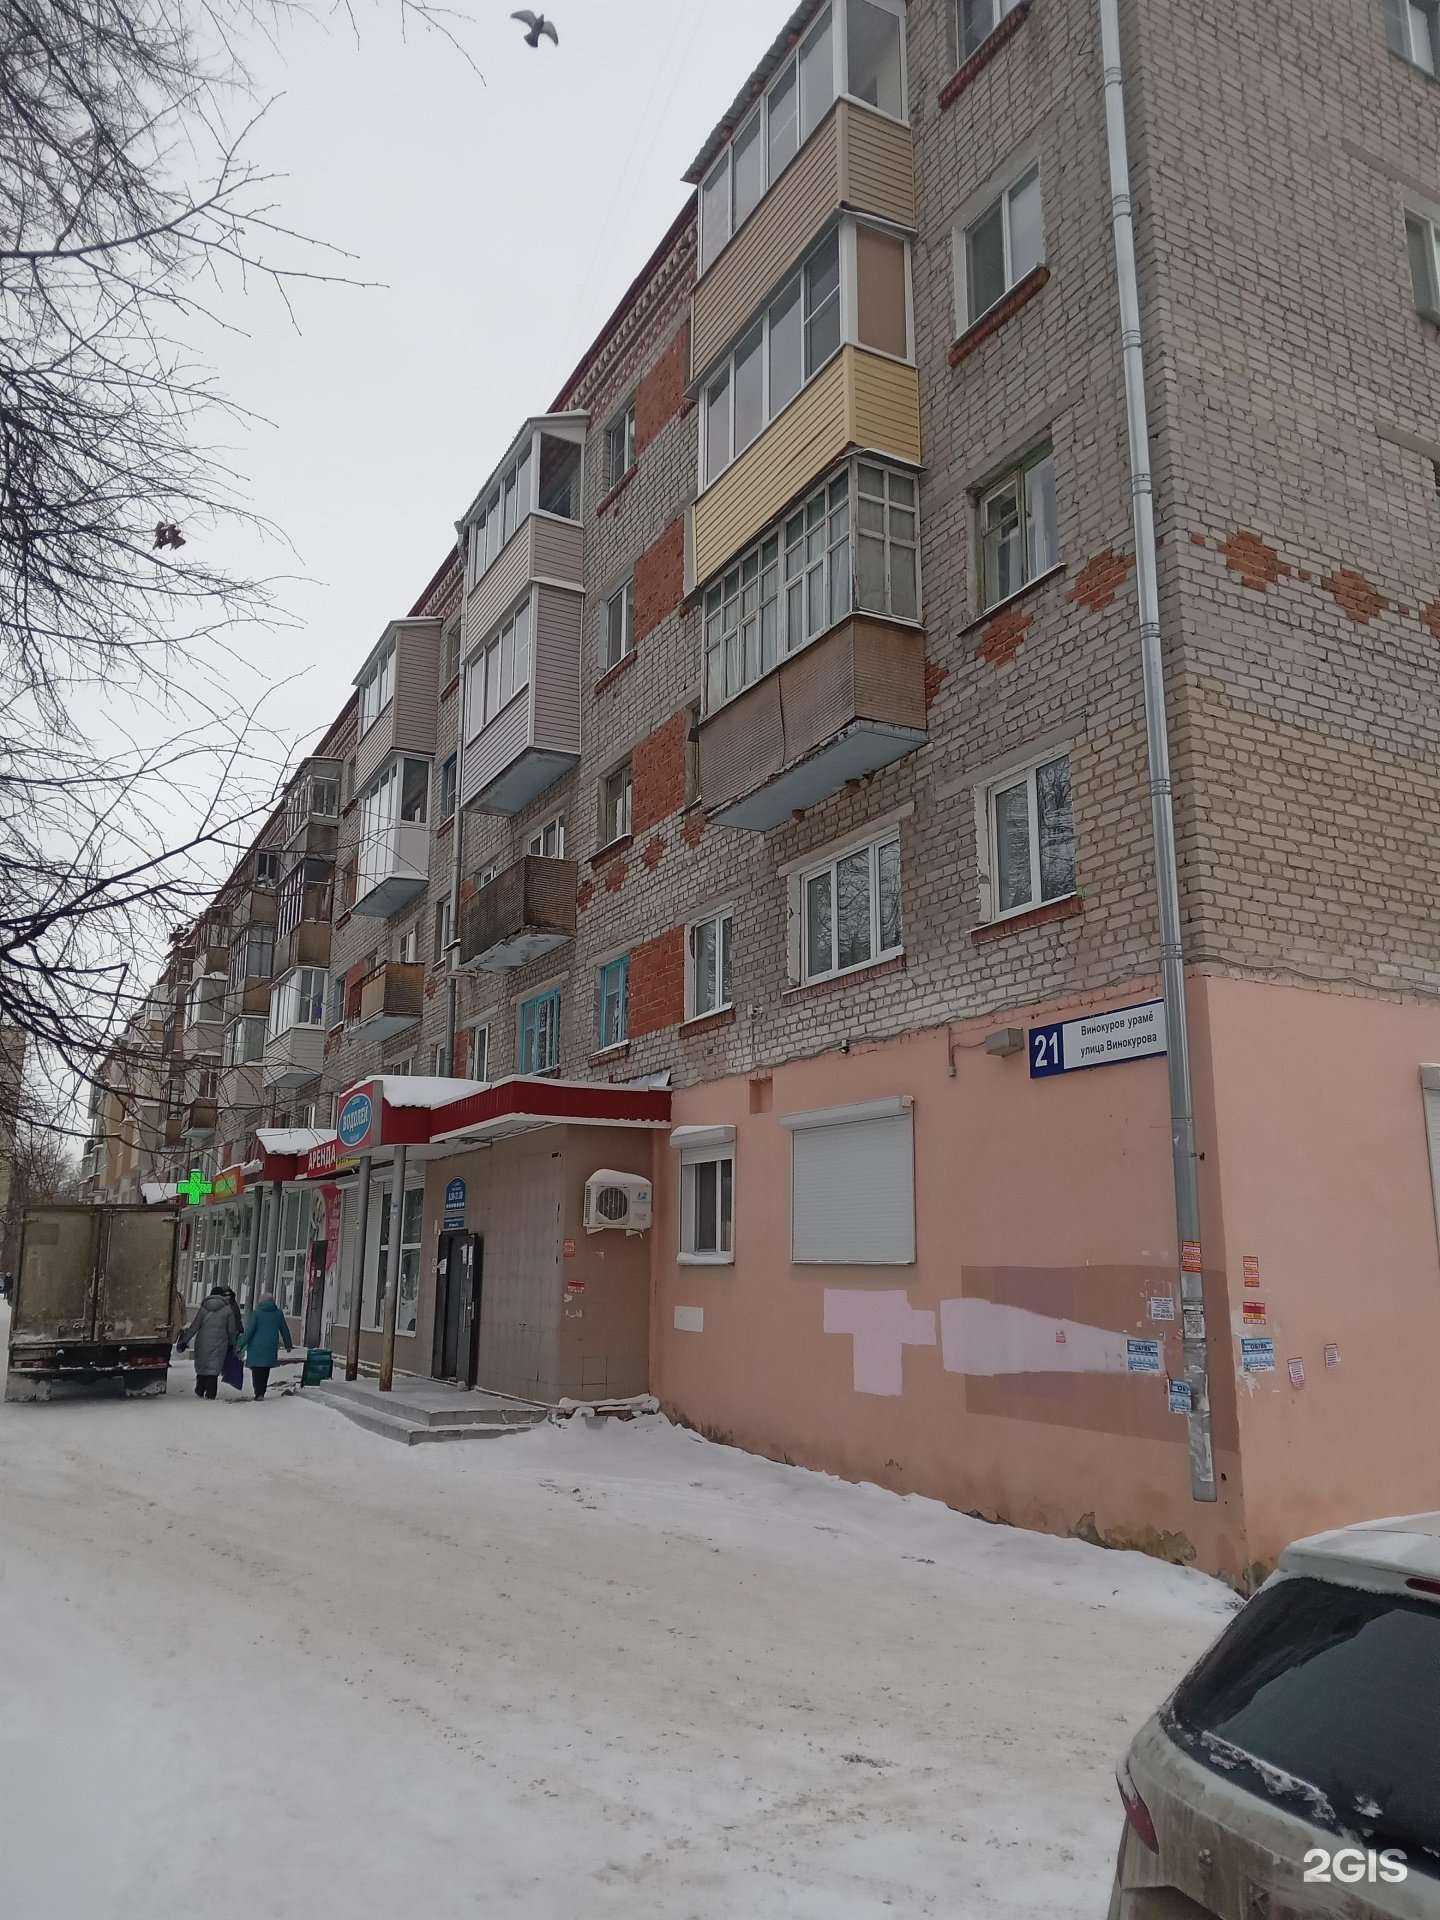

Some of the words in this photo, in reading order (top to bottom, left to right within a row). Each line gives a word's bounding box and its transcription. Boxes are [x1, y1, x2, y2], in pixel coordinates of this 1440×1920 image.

[1081, 1020, 1125, 1036] Винокуров
[1034, 1032, 1059, 1068] 21
[1080, 1042, 1105, 1058] улица
[1106, 1033, 1157, 1051] Винокурова
[308, 1144, 336, 1170] АРЕНДА
